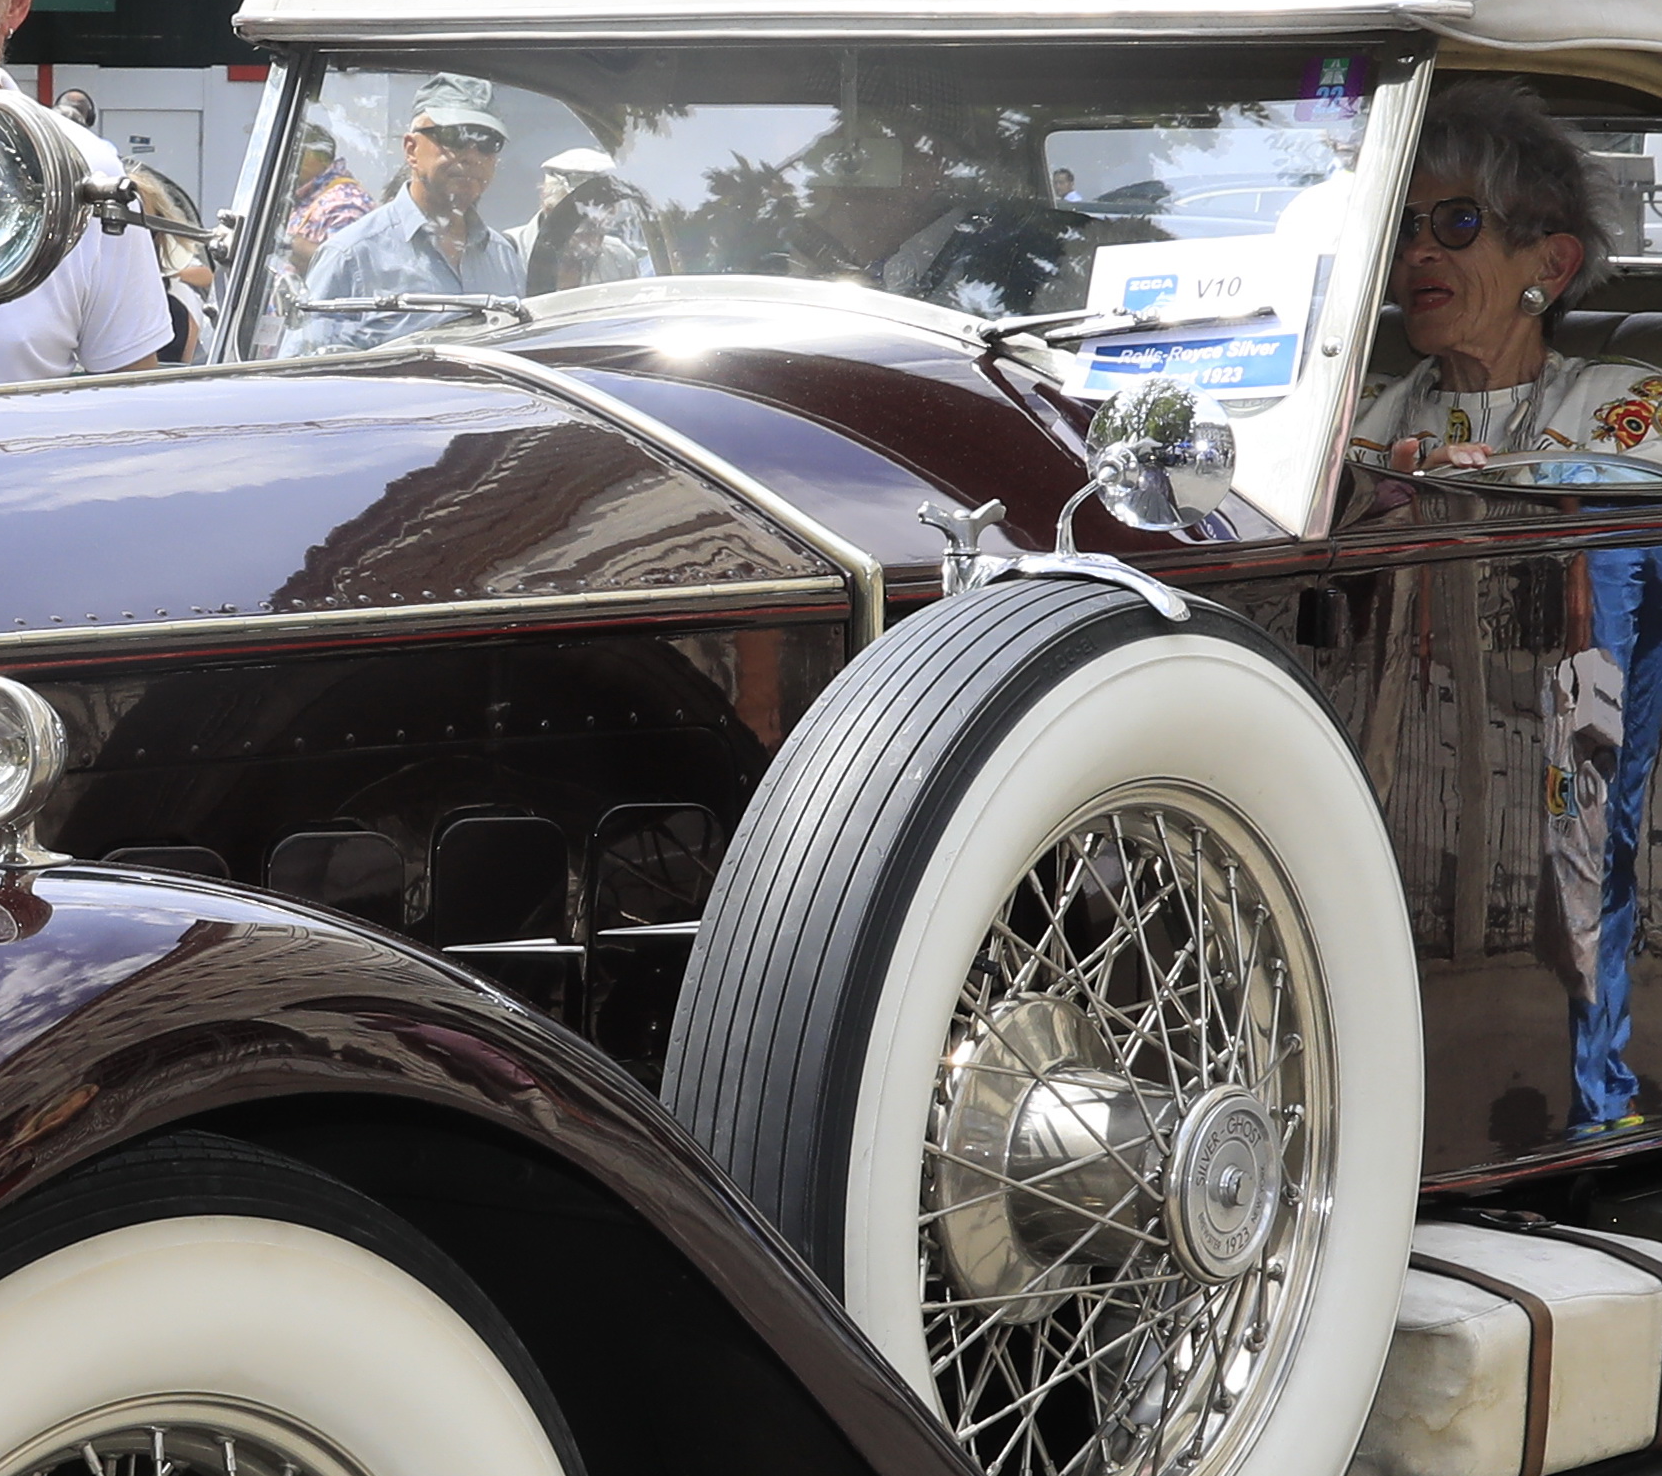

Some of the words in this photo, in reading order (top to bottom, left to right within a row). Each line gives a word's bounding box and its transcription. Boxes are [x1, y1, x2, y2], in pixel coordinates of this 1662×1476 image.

[1129, 278, 1174, 291] ZCCA
[1197, 276, 1242, 299] V10
[1225, 337, 1281, 358] Silver
[1202, 366, 1244, 384] 1923
[1224, 1227, 1251, 1256] 1923
